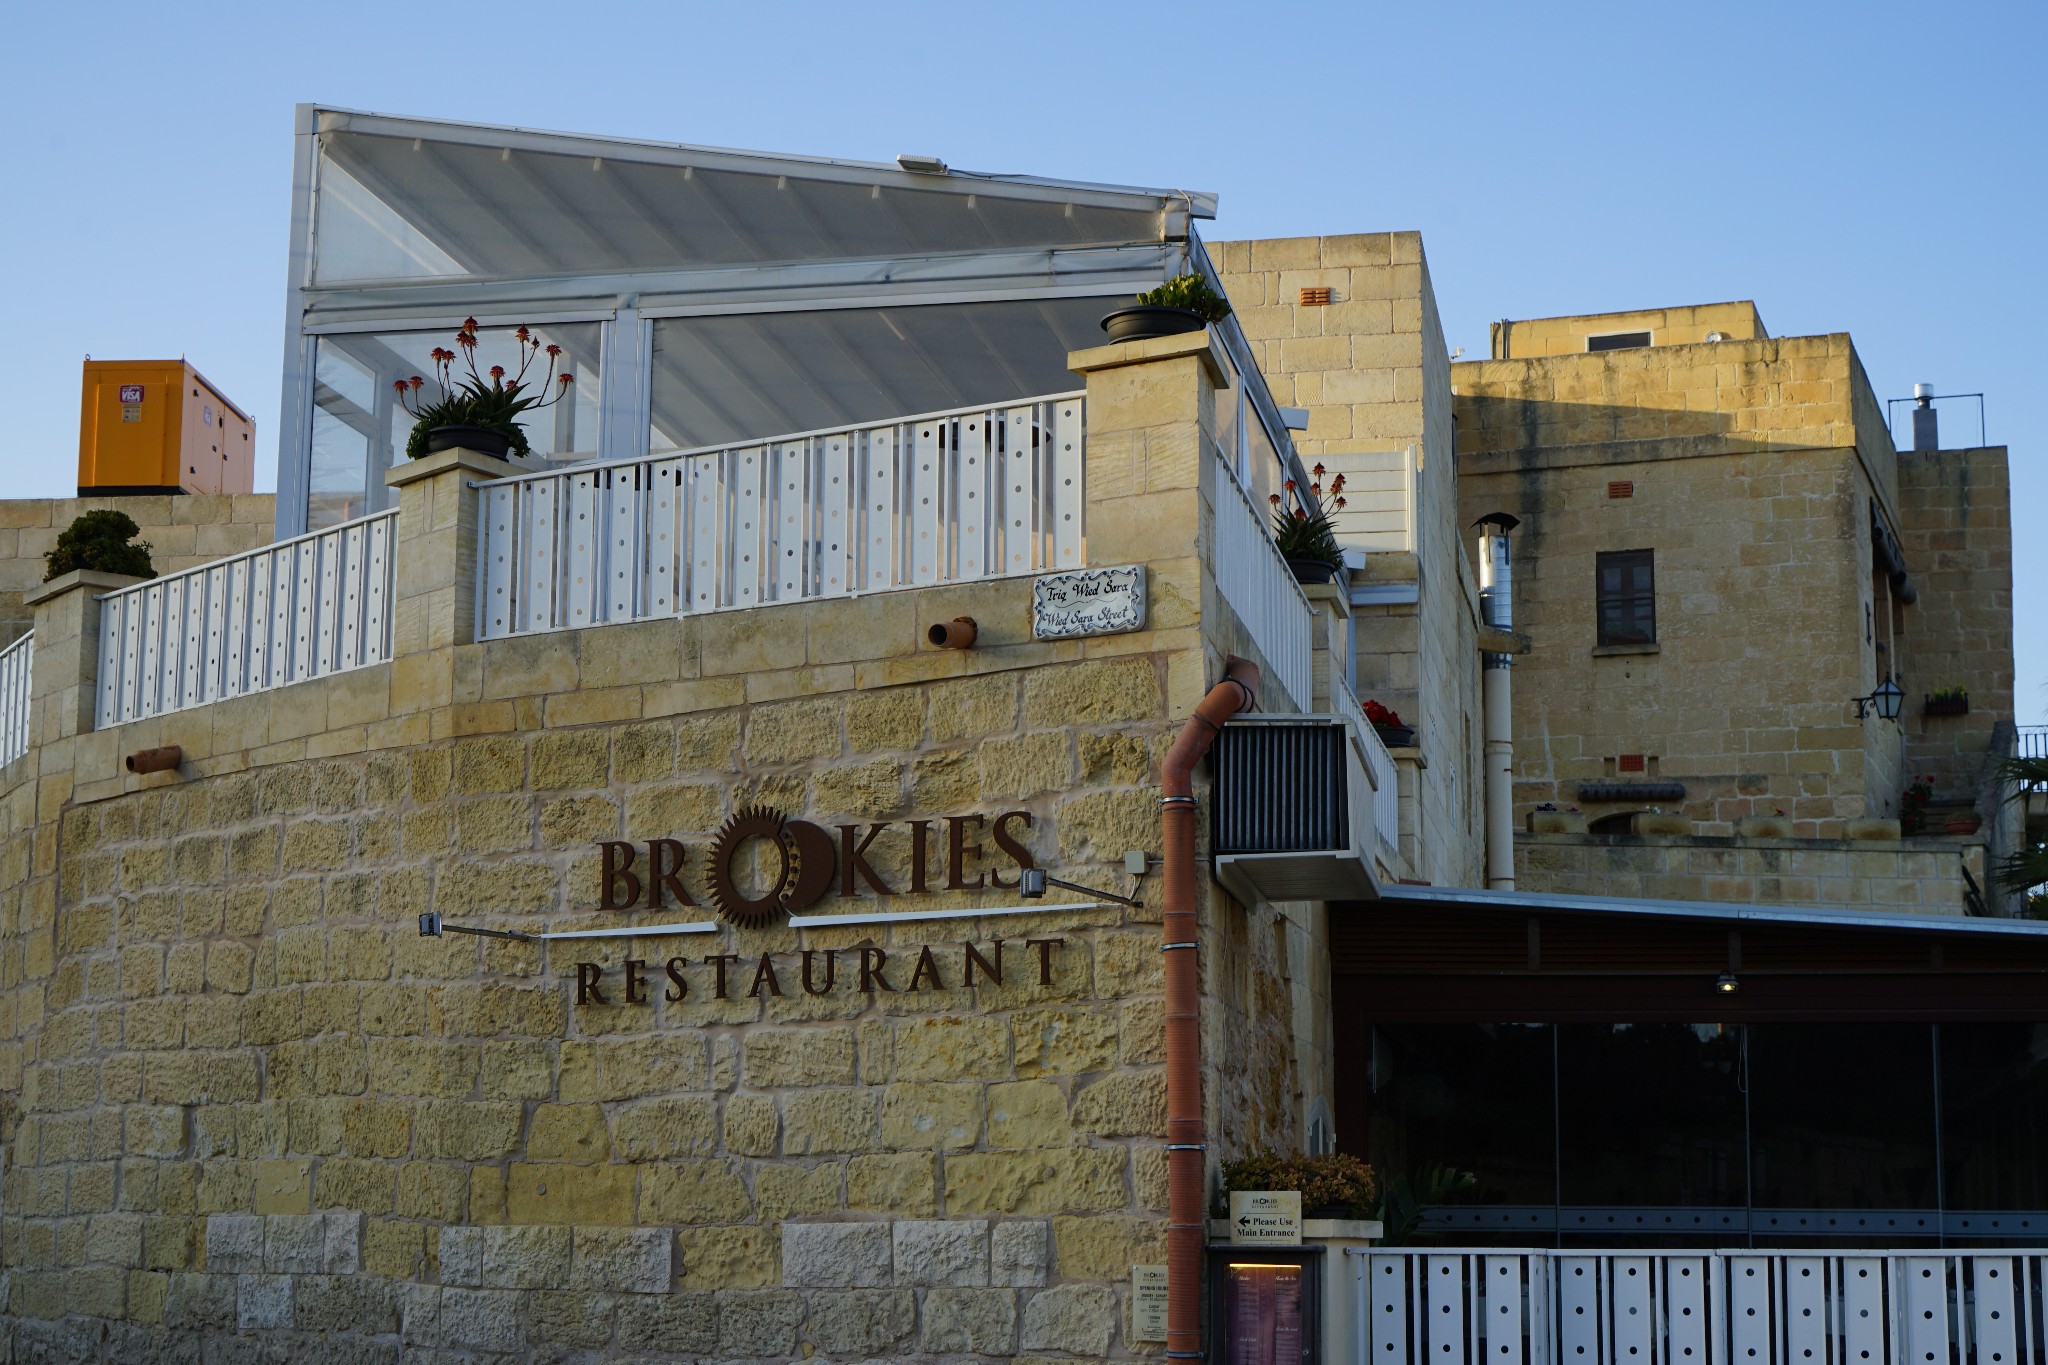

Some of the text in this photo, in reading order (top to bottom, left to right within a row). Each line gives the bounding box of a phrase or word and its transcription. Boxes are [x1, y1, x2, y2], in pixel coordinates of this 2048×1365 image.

[122, 390, 140, 401] VISA
[1072, 582, 1101, 597] Wied
[1104, 580, 1129, 594] Sara
[1042, 605, 1130, 626] Wied Sara Street
[575, 938, 1064, 1006] RESTAURANT
[1253, 1217, 1294, 1226] Please Use
[1237, 1228, 1295, 1237] Main Entrance
